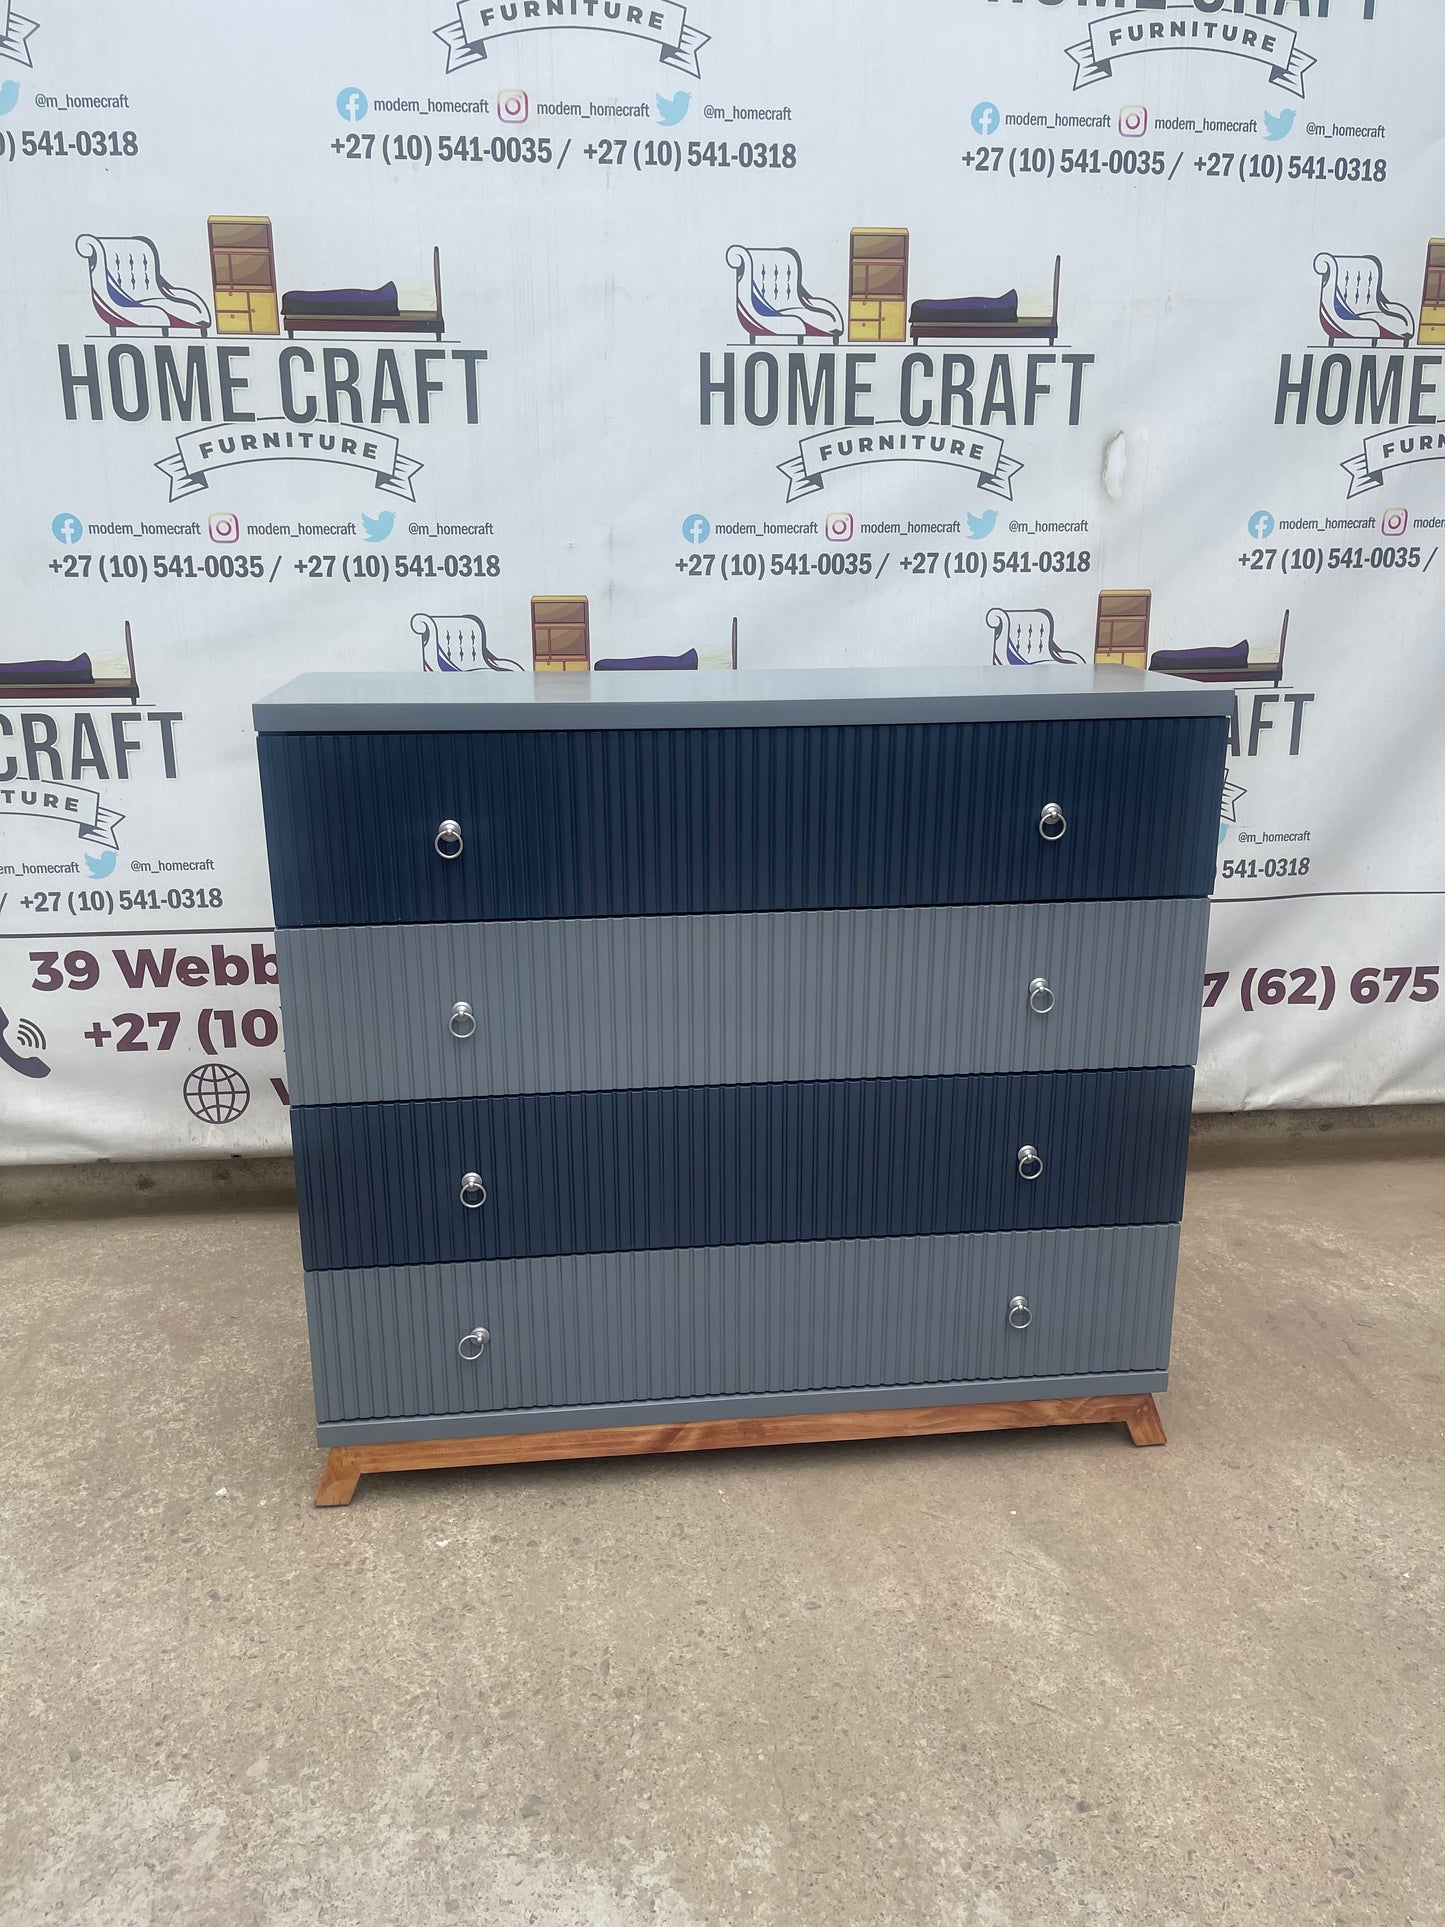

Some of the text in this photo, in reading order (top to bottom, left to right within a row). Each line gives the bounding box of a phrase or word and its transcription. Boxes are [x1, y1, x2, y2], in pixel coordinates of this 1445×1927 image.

[479, 0, 665, 30] FURNITURE
[1109, 21, 1277, 53] FURNITURE
[34, 93, 130, 111] @m_homecraft
[703, 104, 792, 123] @m_homecraft
[21, 130, 139, 157] 541-0318
[1305, 121, 1386, 139] @m_homecraft
[330, 133, 376, 160] +27
[382, 134, 433, 167] (10)
[438, 135, 553, 164] 541-0035
[583, 138, 628, 165] +27
[633, 139, 682, 172] (10)
[687, 141, 797, 169] 541-0318
[961, 146, 1004, 172] +27
[1008, 147, 1055, 179] (10)
[1059, 148, 1165, 175] 541-0035
[1193, 152, 1235, 177] +27
[1238, 153, 1283, 184] (10)
[1287, 155, 1387, 183] 541-0318
[57, 343, 489, 426] HOME CRAFT
[699, 351, 1096, 428] HOME CRAFT
[1274, 353, 1443, 425] HOME
[199, 431, 379, 460] FURNITURE
[819, 434, 985, 461] FURNITURE
[408, 521, 495, 538] @m_homecraft
[1008, 519, 1089, 535] @m_homecraft
[1413, 516, 1445, 529] moder
[48, 554, 92, 578] +27
[98, 554, 148, 583] (10)
[153, 554, 265, 578] 541-0035
[293, 554, 336, 578] +27
[342, 554, 390, 583] (10)
[394, 554, 501, 578] 541-0318
[675, 553, 716, 577] +27
[720, 553, 766, 581] (10)
[770, 552, 873, 576] 541-0035
[899, 551, 940, 574] +27
[943, 551, 988, 579] (10)
[992, 550, 1091, 574] 541-0318
[1238, 548, 1278, 570] +27
[1281, 547, 1324, 575] (10)
[1327, 546, 1421, 570] 541-0035
[0, 789, 79, 813] TURE
[1238, 830, 1311, 845] @m_homecraft
[130, 858, 215, 874] @m_homecraft
[1221, 856, 1311, 879] 541-0318
[20, 891, 62, 913] +27
[67, 890, 114, 916] (10)
[119, 887, 224, 911] 541-0318
[28, 943, 280, 992] 39 Webb
[1240, 965, 1336, 1012] (62)
[1349, 965, 1440, 1005] 675
[83, 1008, 279, 1056] +27 (10
